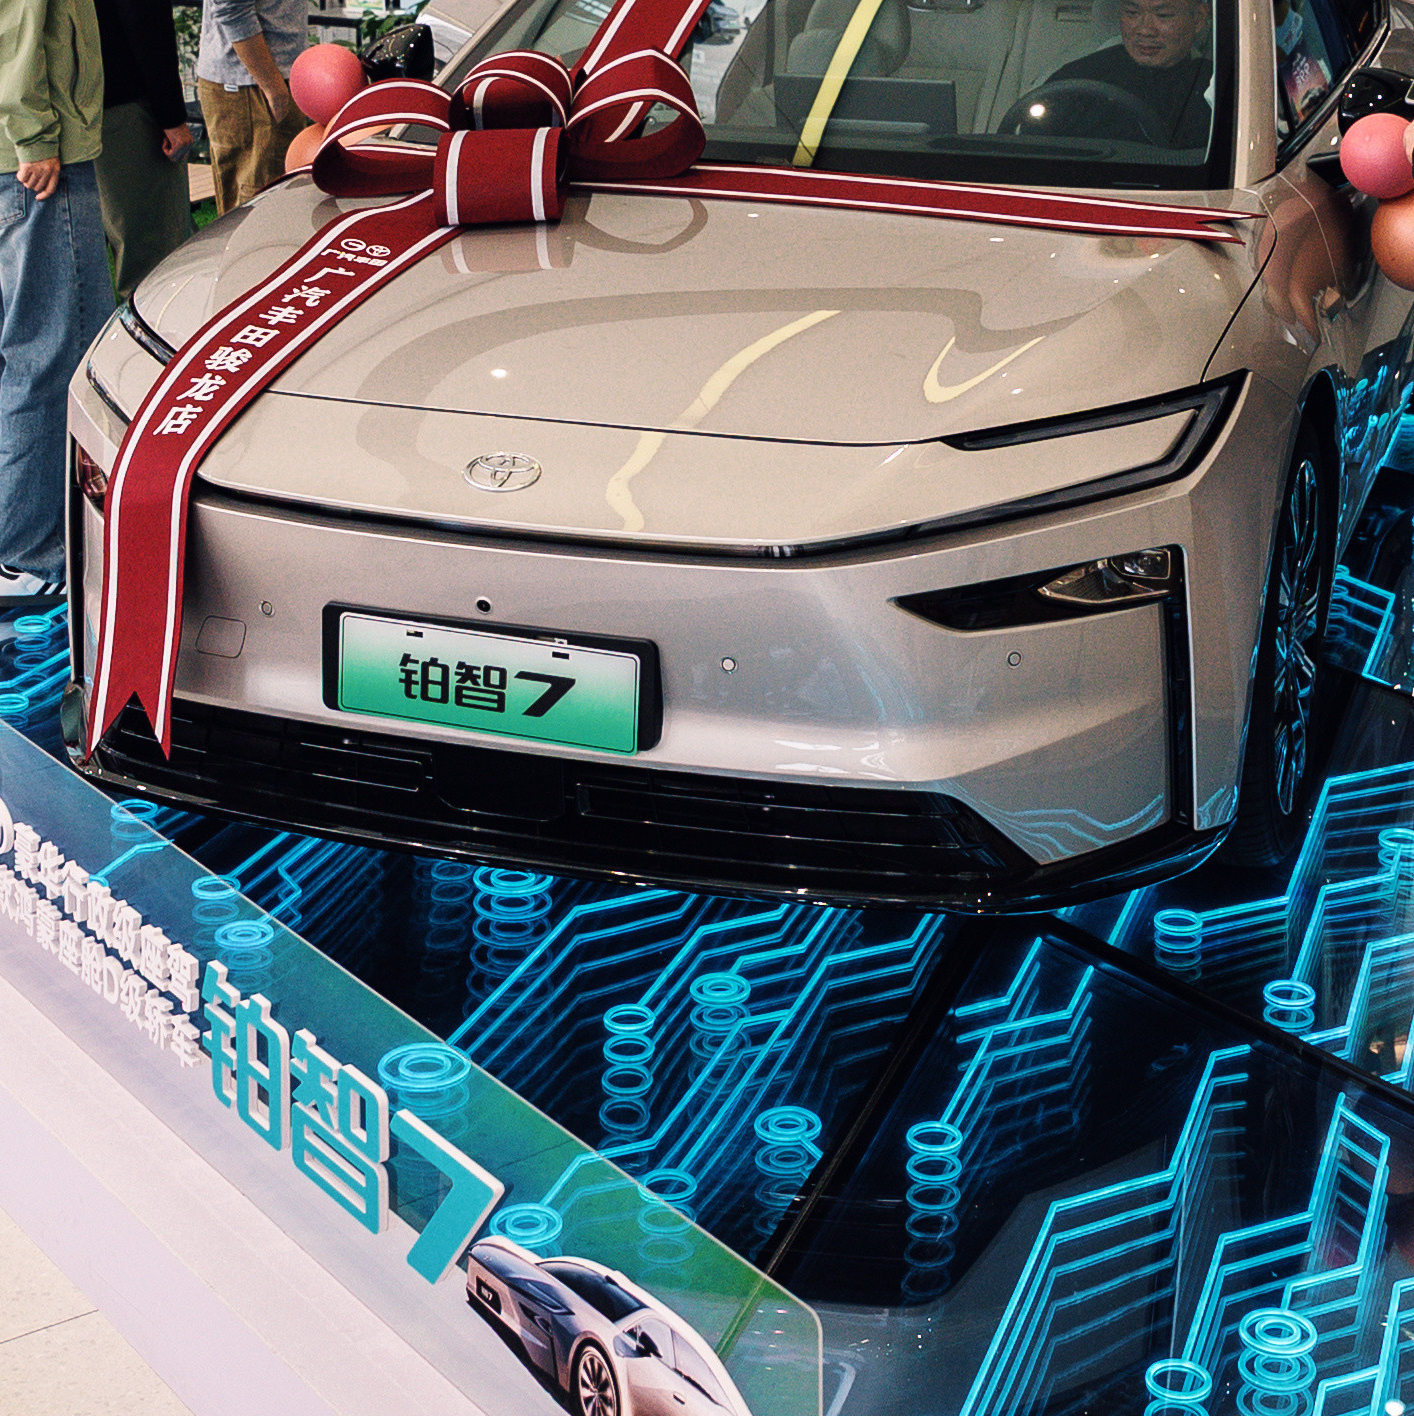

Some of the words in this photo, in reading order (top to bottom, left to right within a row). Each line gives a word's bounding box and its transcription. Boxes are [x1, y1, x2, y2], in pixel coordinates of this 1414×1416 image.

[320, 248, 388, 268] 广汽丰田
[153, 266, 356, 436] 广汽丰田骏龙店
[398, 652, 577, 718] 铂智7
[13, 821, 199, 1013] 豪华行政级座驾
[202, 959, 505, 1286] 铂智7
